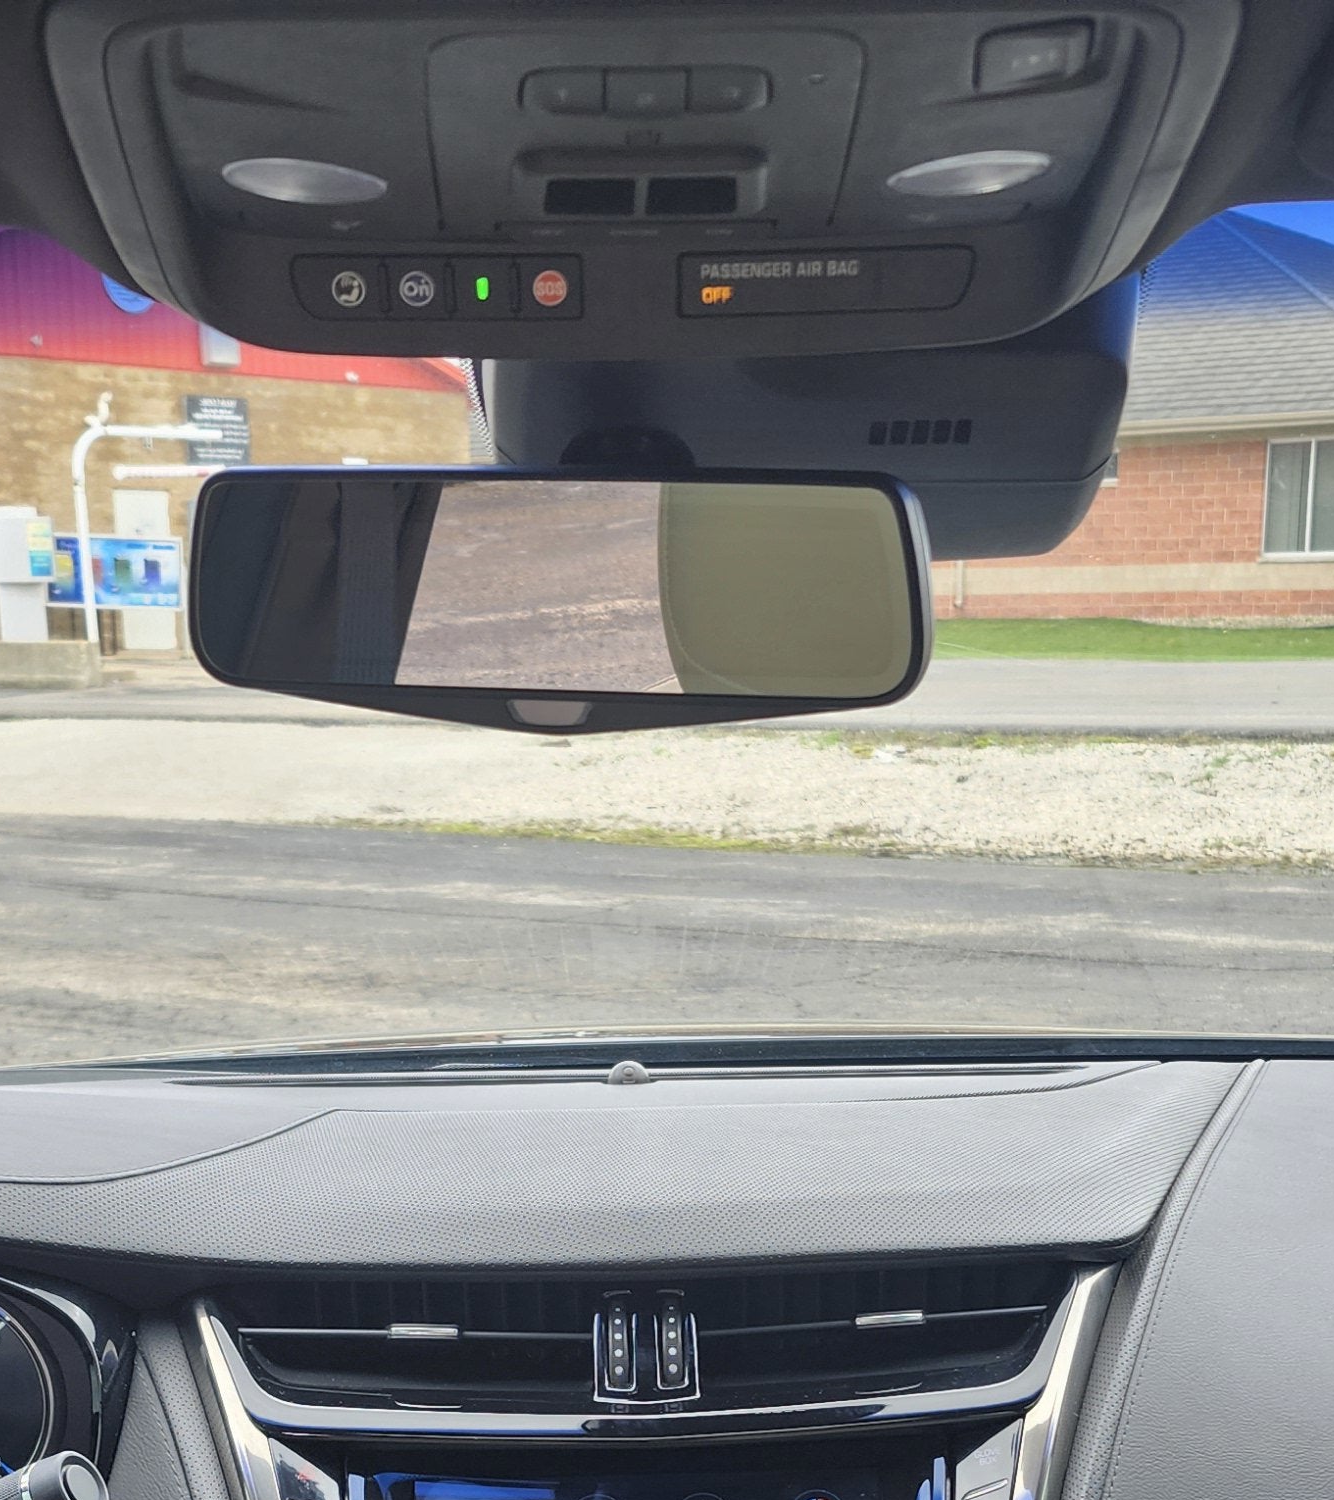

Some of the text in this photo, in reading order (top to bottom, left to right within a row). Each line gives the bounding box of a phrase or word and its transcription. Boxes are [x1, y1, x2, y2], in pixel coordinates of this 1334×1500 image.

[700, 260, 859, 279] PASSENGER AIR BAG
[535, 281, 564, 296] SOS
[701, 286, 733, 305] OFF
